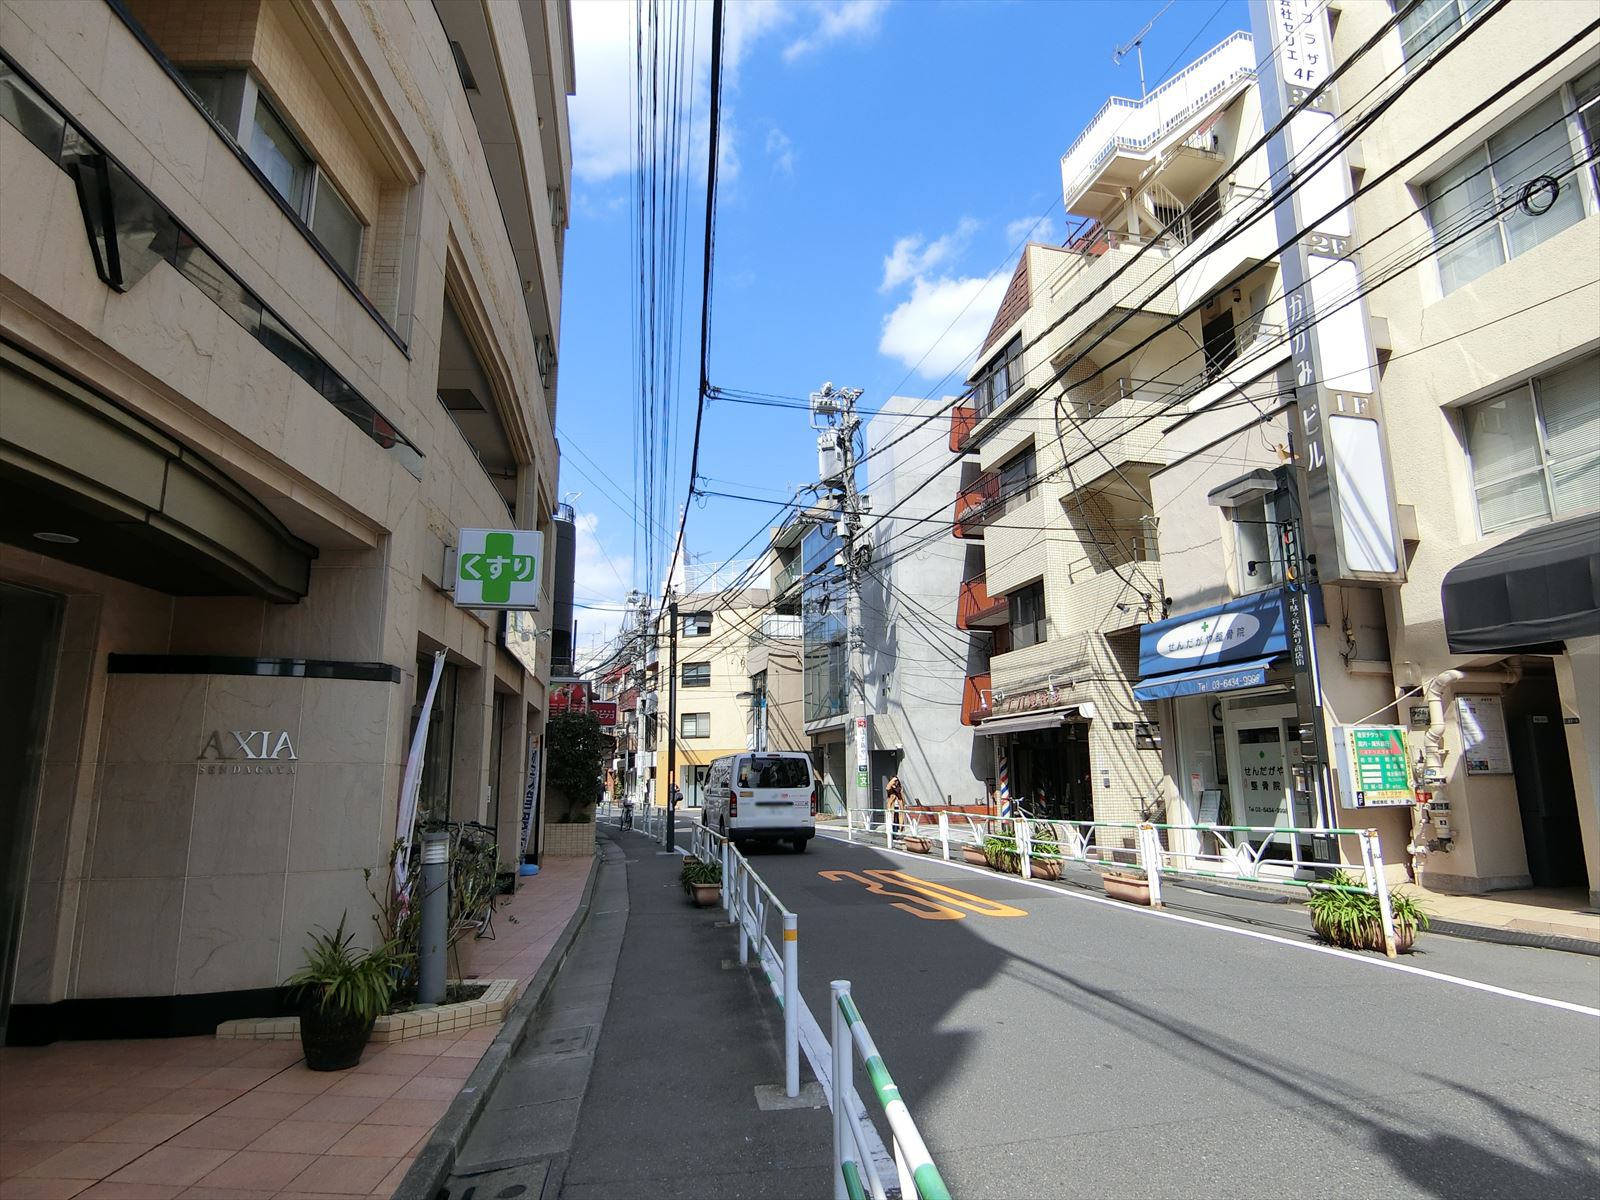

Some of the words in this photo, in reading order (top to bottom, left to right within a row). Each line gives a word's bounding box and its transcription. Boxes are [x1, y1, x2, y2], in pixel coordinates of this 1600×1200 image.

[1294, 67, 1315, 81] 4F
[1312, 235, 1348, 255] 2F
[1336, 393, 1370, 415] 1F
[464, 555, 532, 580] くすり
[196, 729, 299, 761] AXIA
[197, 764, 297, 775] SENDAGAYA
[1244, 765, 1284, 777] せんだがや
[818, 870, 1029, 920] 30
